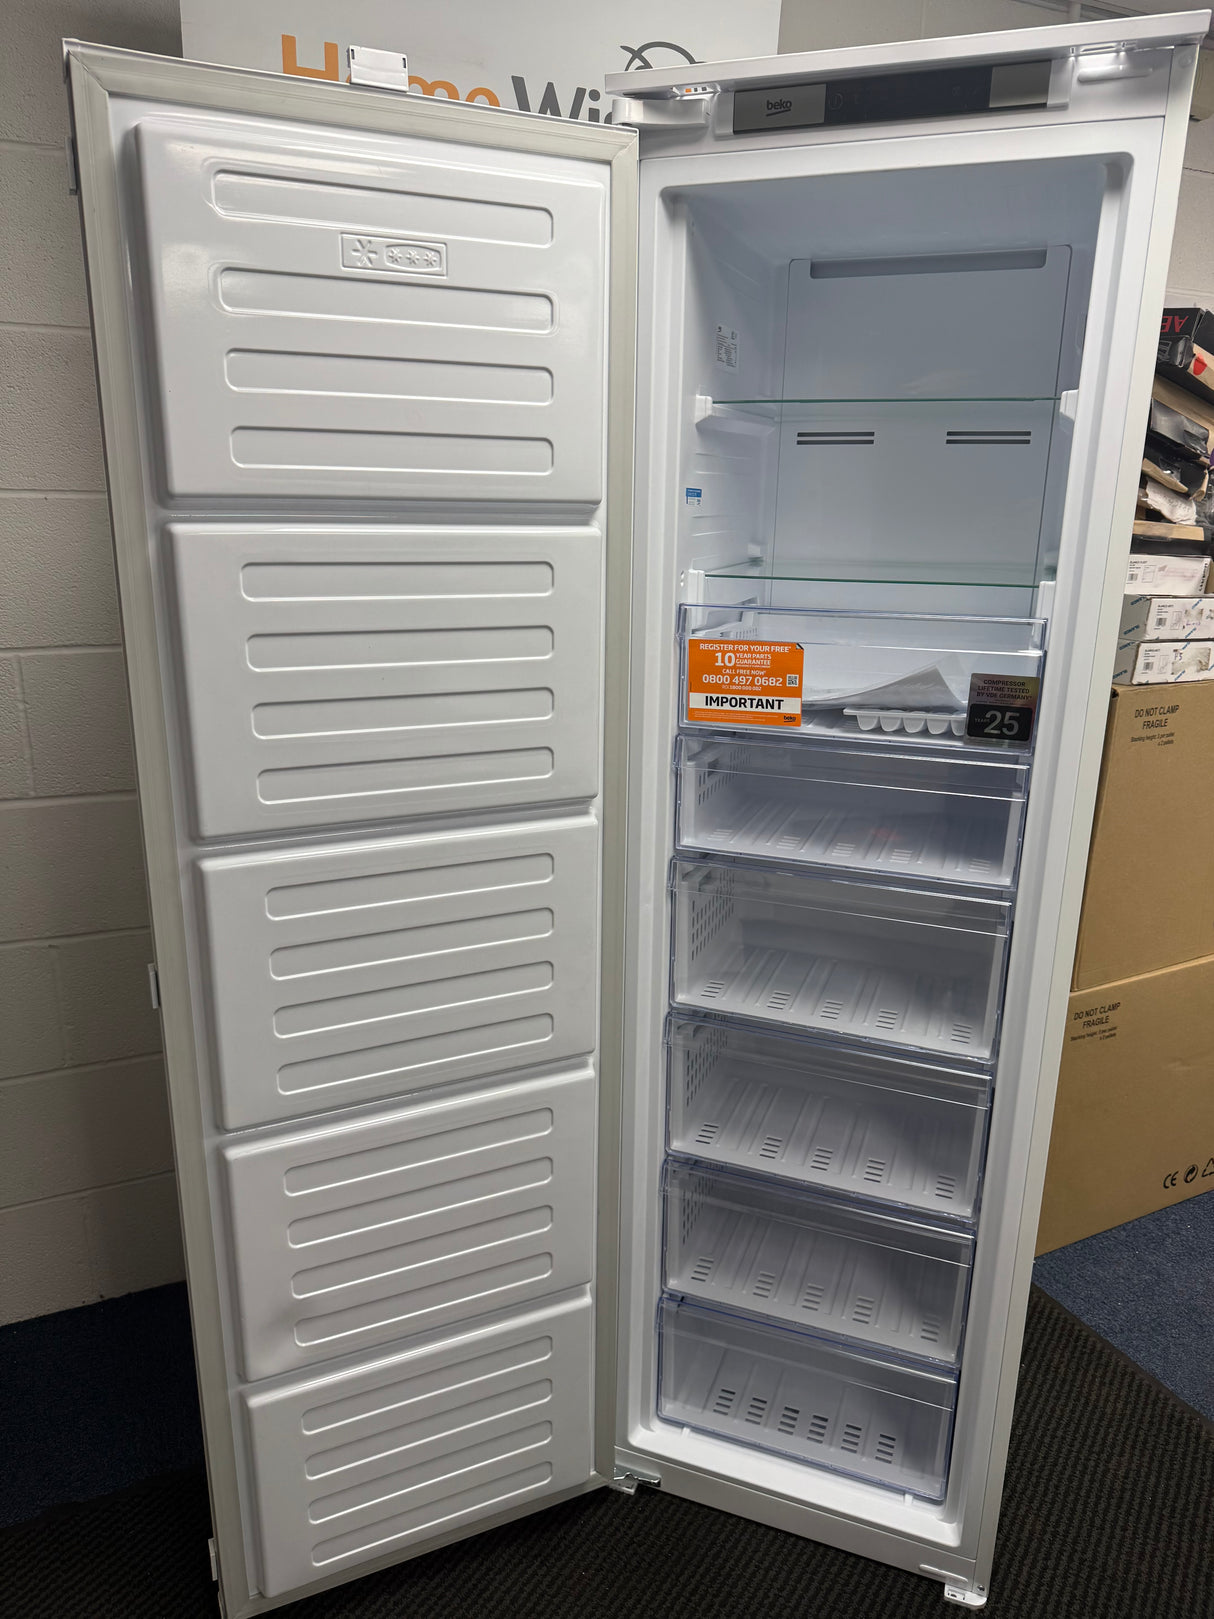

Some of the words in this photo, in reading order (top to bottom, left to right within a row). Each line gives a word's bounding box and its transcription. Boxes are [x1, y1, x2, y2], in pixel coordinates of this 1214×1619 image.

[766, 99, 792, 111] beko
[700, 643, 733, 651] REGISTER
[734, 644, 749, 652] FOR
[749, 645, 770, 653] YOUR
[714, 652, 735, 666] 10
[702, 674, 730, 684] 0800
[732, 675, 753, 685] 497
[754, 676, 783, 687] 0682
[705, 695, 784, 710] IMPORTANT
[1134, 708, 1144, 718] DO
[1145, 707, 1158, 717] NOT
[1158, 704, 1180, 716] CLAMP
[983, 710, 1020, 736] 25
[1142, 718, 1169, 730] FRAGILE
[1073, 1011, 1084, 1021] DO
[1084, 1007, 1098, 1018] NOT
[1098, 1002, 1121, 1015] CLAMP
[1082, 1015, 1110, 1029] FRAGILE
